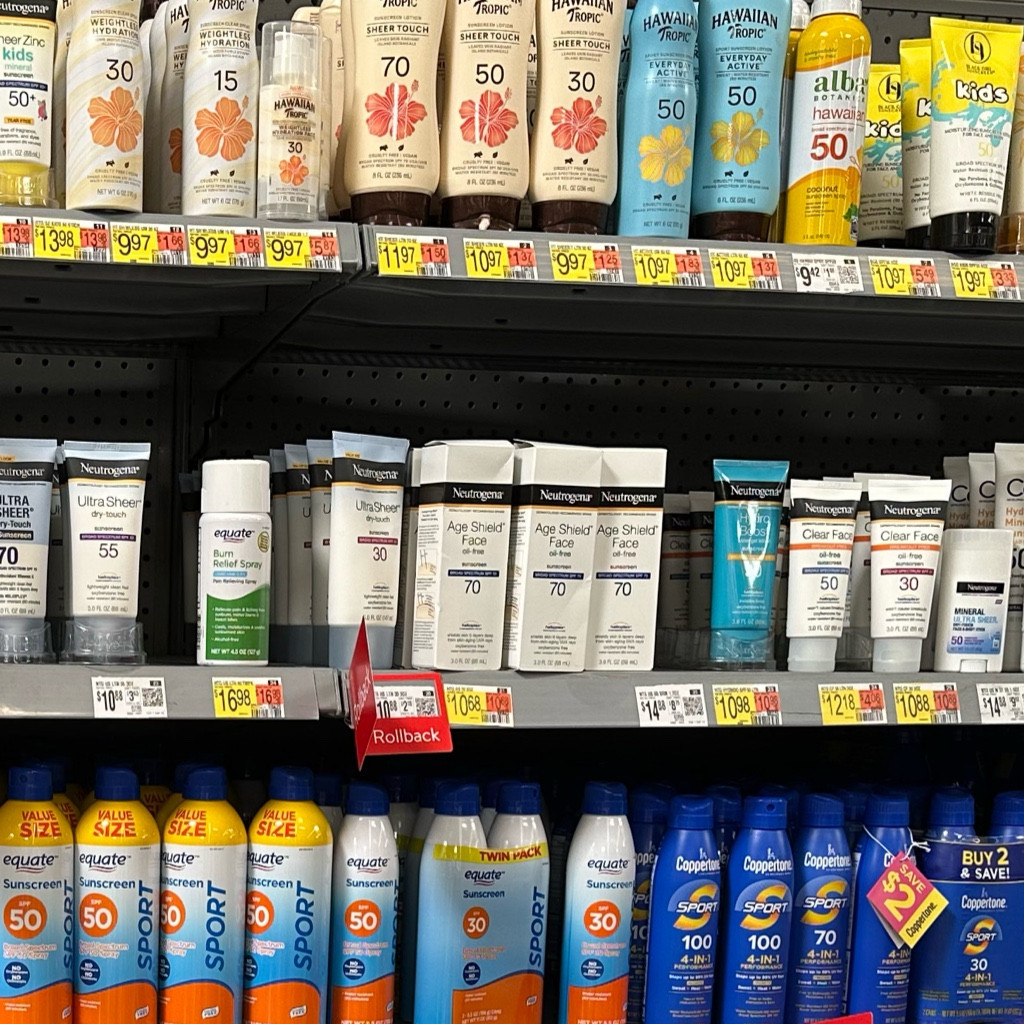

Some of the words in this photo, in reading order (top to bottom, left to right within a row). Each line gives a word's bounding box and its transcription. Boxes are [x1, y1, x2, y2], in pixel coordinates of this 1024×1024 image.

[200, 31, 250, 40] WEIGHTLESS
[367, 25, 395, 34] SHEER
[398, 25, 429, 34] TOUCH
[22, 34, 45, 47] Zinc
[460, 32, 488, 40] SHEER
[491, 32, 520, 41] TOUCH
[201, 40, 250, 49] HYDRATION
[3, 48, 33, 61] kids
[5, 62, 32, 71] mineral
[106, 59, 133, 82] 30
[381, 57, 409, 76] 70
[728, 62, 760, 70] ACTIVE
[476, 64, 504, 84] 50
[214, 71, 237, 91] 15
[568, 72, 595, 91] 30
[956, 81, 1008, 103] kids
[9, 91, 36, 107] 50+
[275, 99, 315, 111] HAWAIIAN
[658, 100, 685, 120] 50
[811, 134, 848, 161] 50
[448, 522, 468, 534] Age
[215, 529, 255, 541] equate
[462, 535, 486, 546] Face
[881, 530, 910, 542] Clear
[913, 531, 938, 542] Face
[99, 544, 118, 558] 55
[214, 549, 233, 558] Burn
[214, 559, 237, 568] Relief
[240, 560, 262, 570] Spray
[899, 576, 919, 591] 30
[954, 608, 985, 616] MINERAL
[21, 811, 56, 821] VALUE
[20, 822, 62, 838] SIZE
[480, 852, 510, 861] TWIN
[513, 846, 541, 859] PACK
[962, 851, 993, 866] BUY
[997, 848, 1009, 864] 2
[3, 853, 58, 869] equate
[744, 856, 792, 874] Coppertone
[899, 864, 925, 893] SAVE
[961, 868, 969, 879] &
[975, 868, 1010, 879] SAVE!
[4, 878, 62, 890] Sunscreen
[463, 890, 504, 899] Sunscreen
[9, 908, 41, 930] 50
[205, 880, 226, 972] SPORT
[748, 935, 781, 950] 100
[746, 954, 780, 964] 4-IN-1
[970, 959, 988, 971] 30
